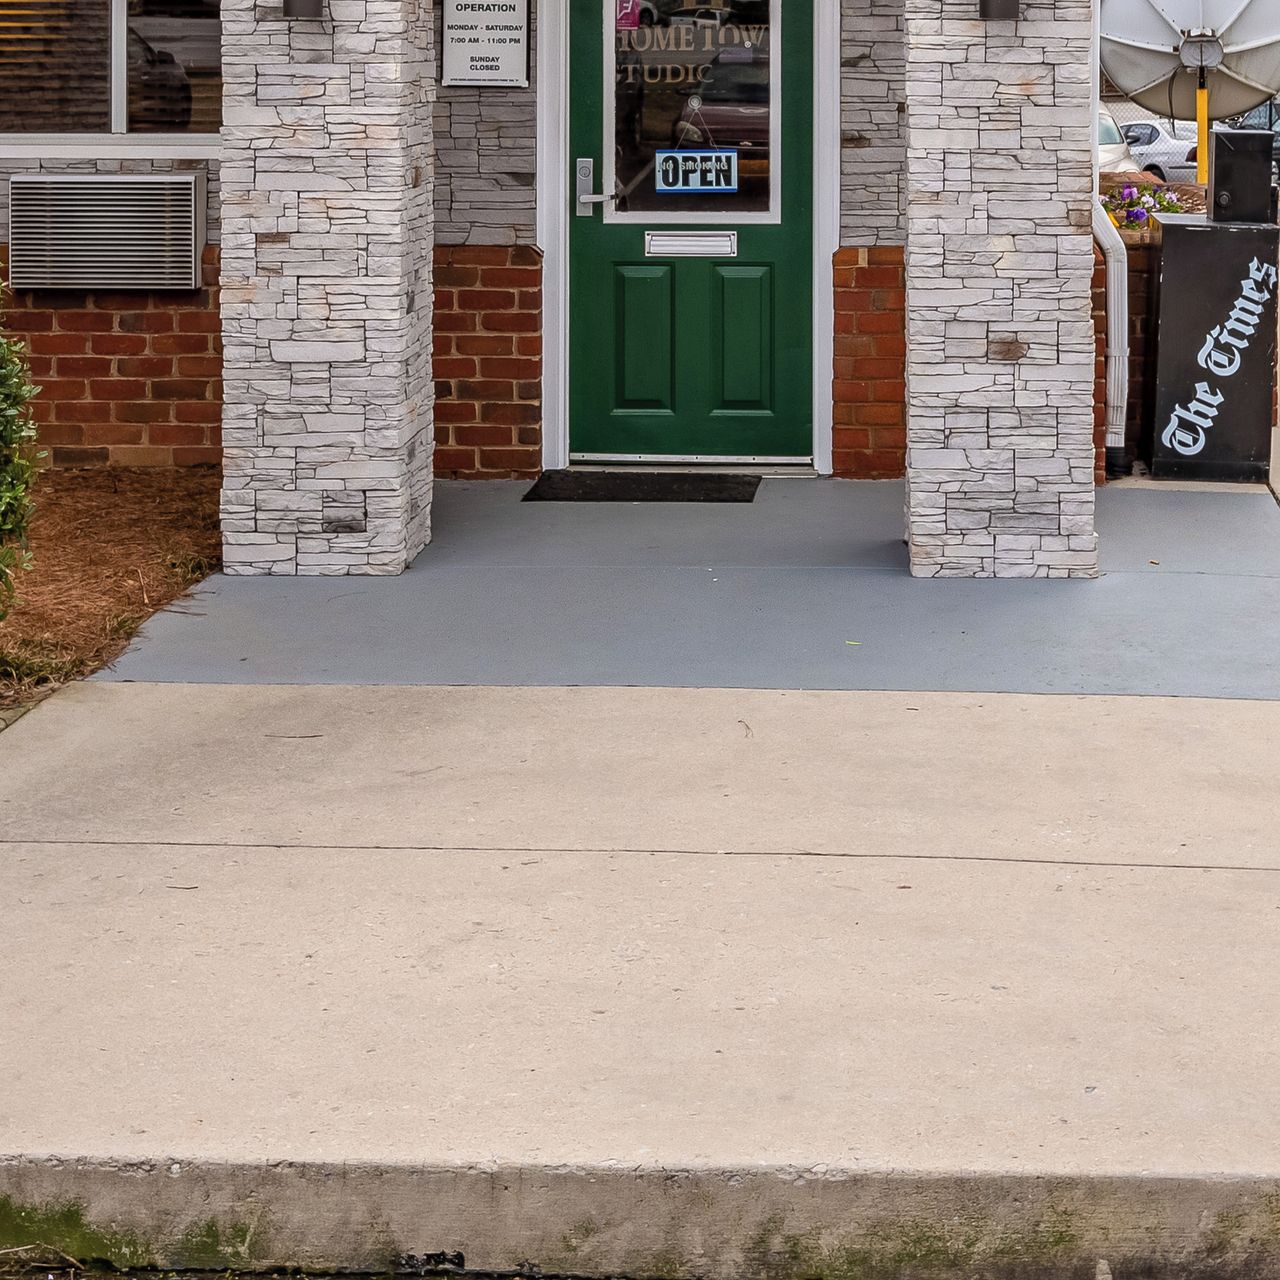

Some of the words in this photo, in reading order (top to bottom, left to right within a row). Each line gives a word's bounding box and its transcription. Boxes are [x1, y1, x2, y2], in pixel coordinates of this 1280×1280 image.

[455, 3, 517, 13] OPERATION
[485, 24, 524, 32] SATURDAY
[487, 37, 507, 45] 11:00
[508, 37, 521, 45] PM
[661, 155, 733, 188] OPEN
[1161, 381, 1225, 456] The
[1197, 256, 1278, 377] Times
